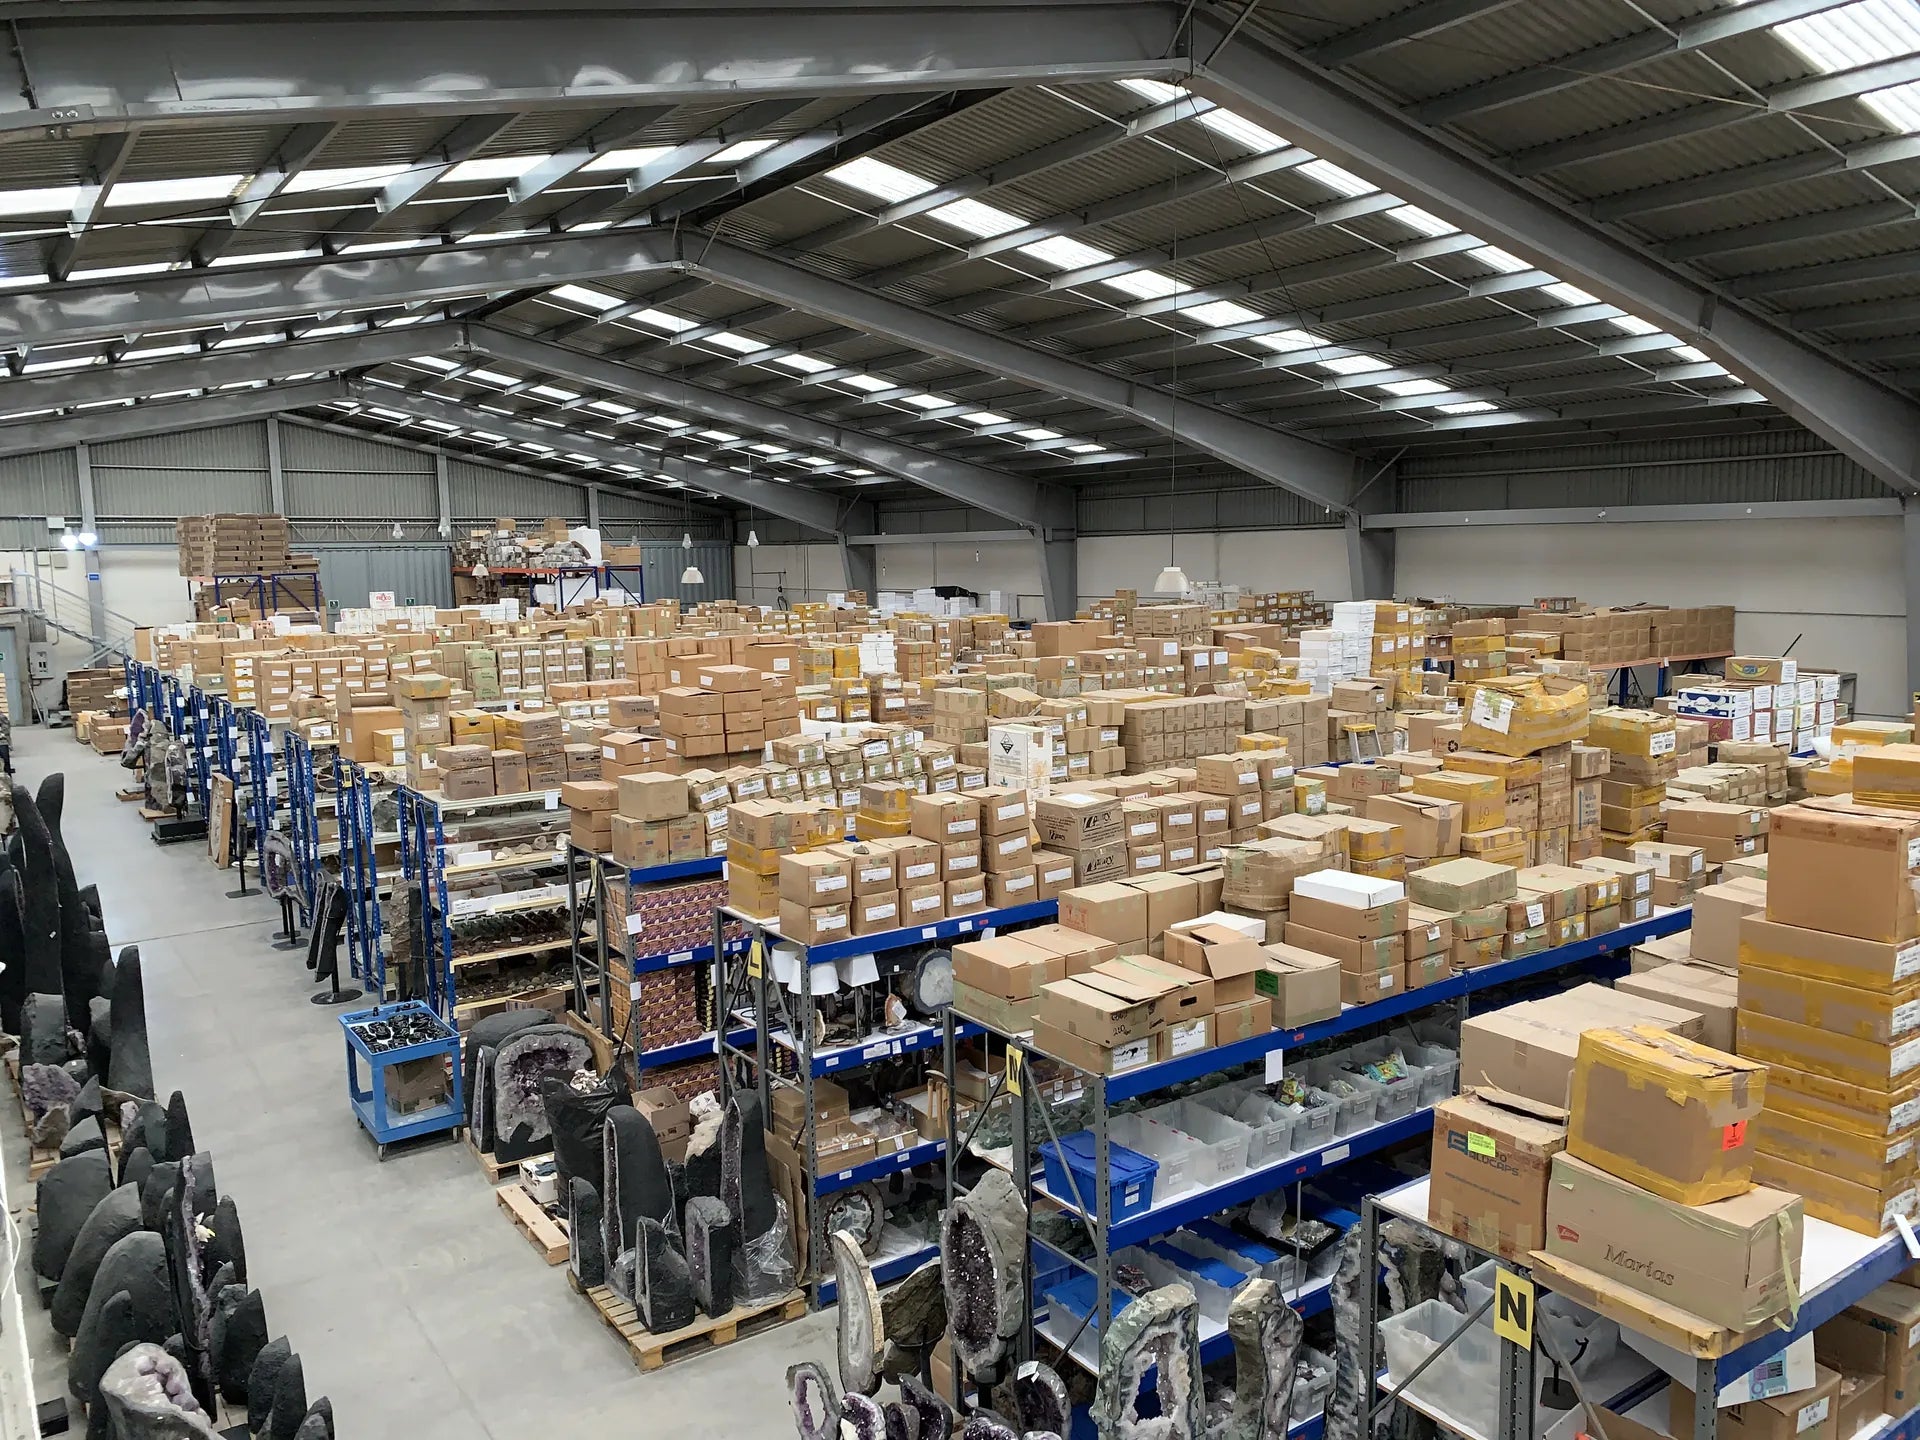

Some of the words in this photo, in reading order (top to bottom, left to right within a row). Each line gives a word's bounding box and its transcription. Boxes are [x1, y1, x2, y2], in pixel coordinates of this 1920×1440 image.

[750, 947, 759, 969] L
[1603, 1244, 1675, 1286] Marias
[1500, 1282, 1527, 1332] N
